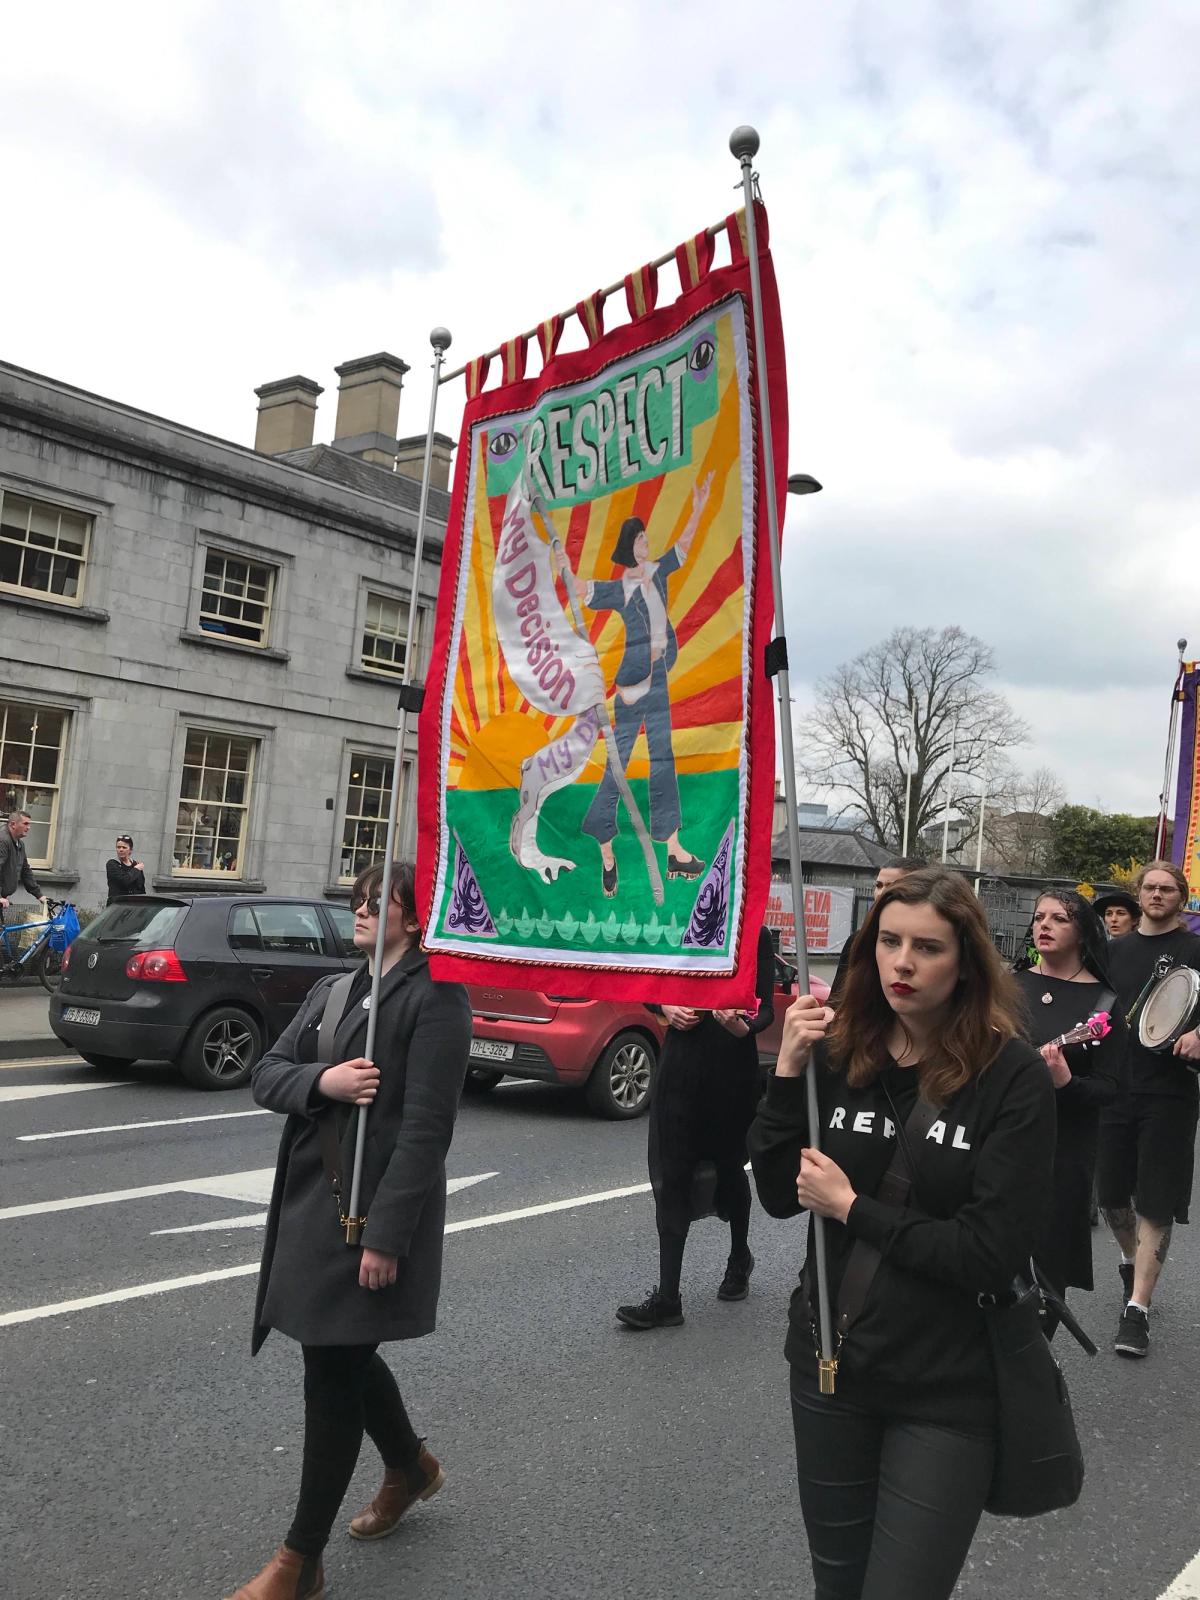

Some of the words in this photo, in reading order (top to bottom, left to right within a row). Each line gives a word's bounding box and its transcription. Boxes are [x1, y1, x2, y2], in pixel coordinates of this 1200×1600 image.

[524, 354, 688, 499] RESPECT
[505, 561, 575, 710] Decision
[804, 890, 832, 914] EVA
[829, 1106, 971, 1150] REPAL
